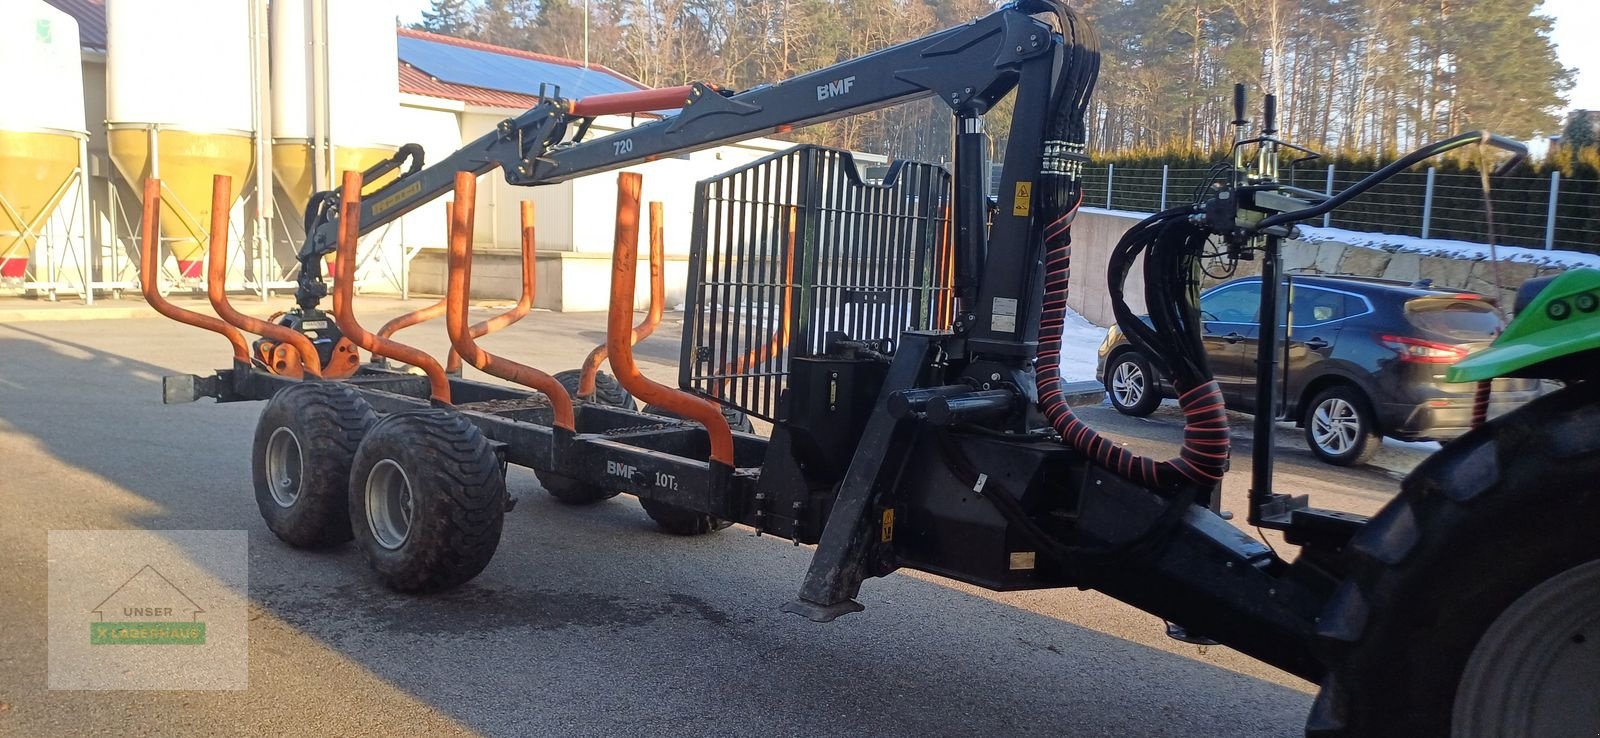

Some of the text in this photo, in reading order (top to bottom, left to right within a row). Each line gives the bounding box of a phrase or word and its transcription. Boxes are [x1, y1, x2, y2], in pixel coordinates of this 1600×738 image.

[816, 75, 856, 101] BMF
[613, 138, 633, 156] 720
[607, 460, 637, 479] BMF
